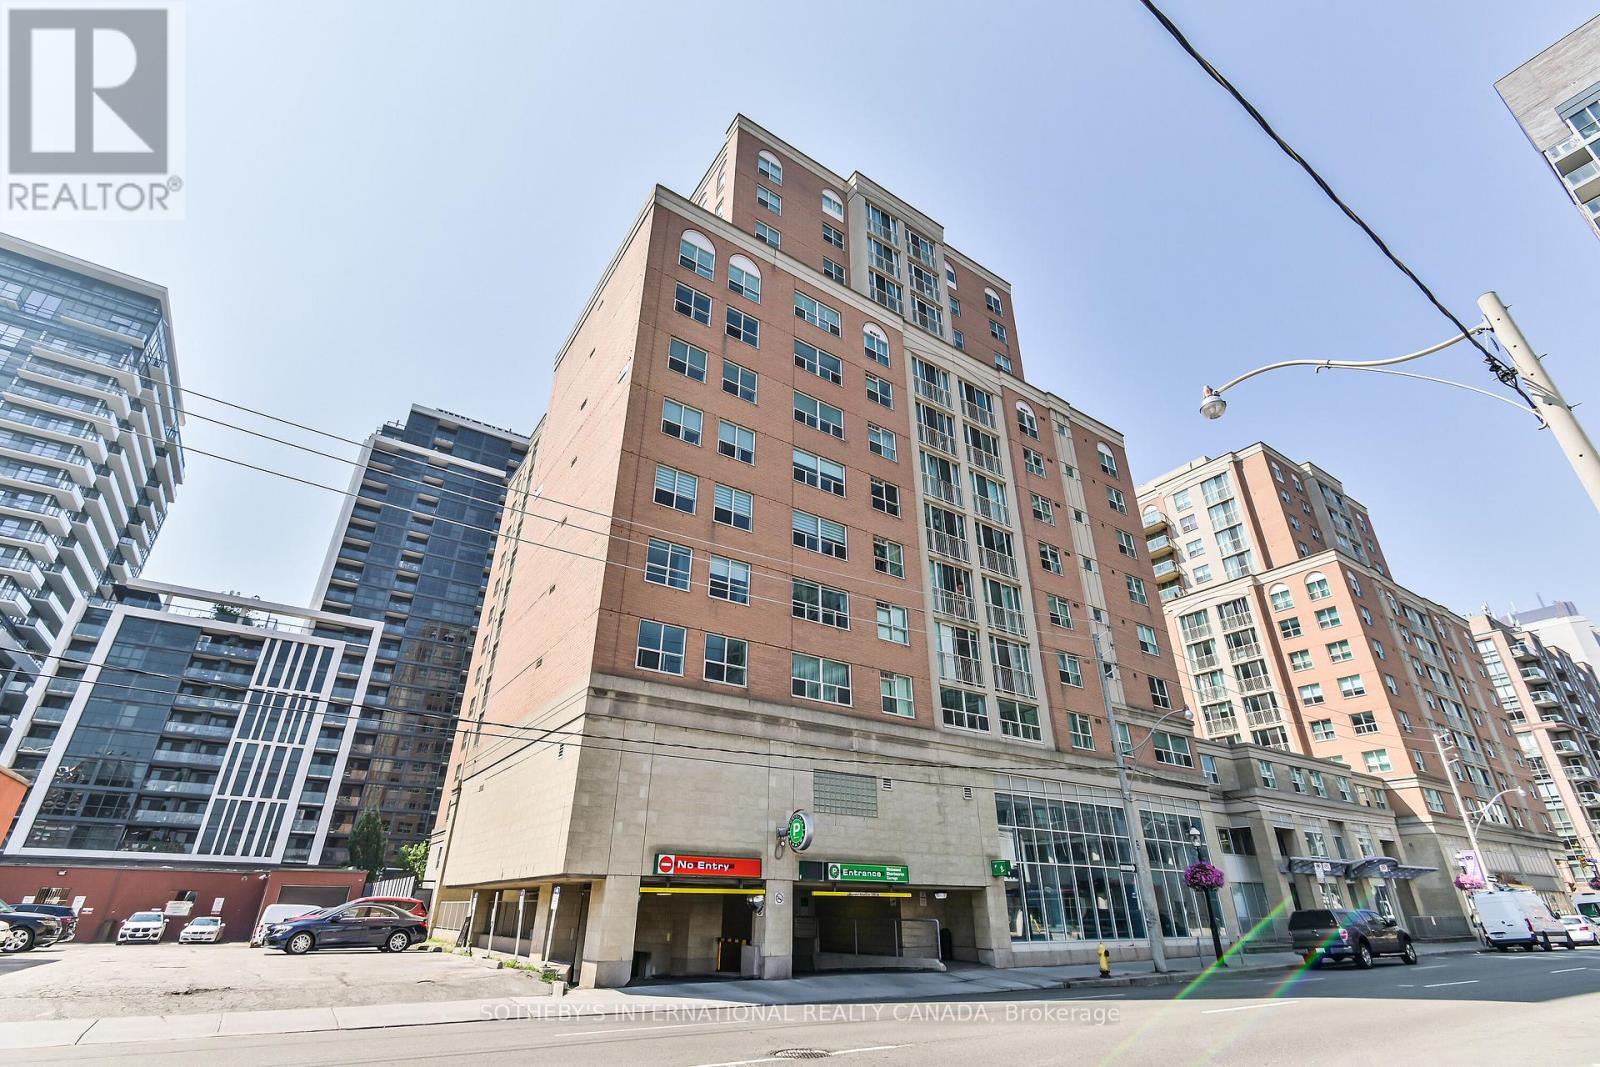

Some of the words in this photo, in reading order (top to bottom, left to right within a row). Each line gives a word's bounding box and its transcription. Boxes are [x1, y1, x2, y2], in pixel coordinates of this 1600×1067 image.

[677, 860, 694, 869] No
[697, 861, 730, 872] Entry
[842, 868, 882, 878] Entrance
